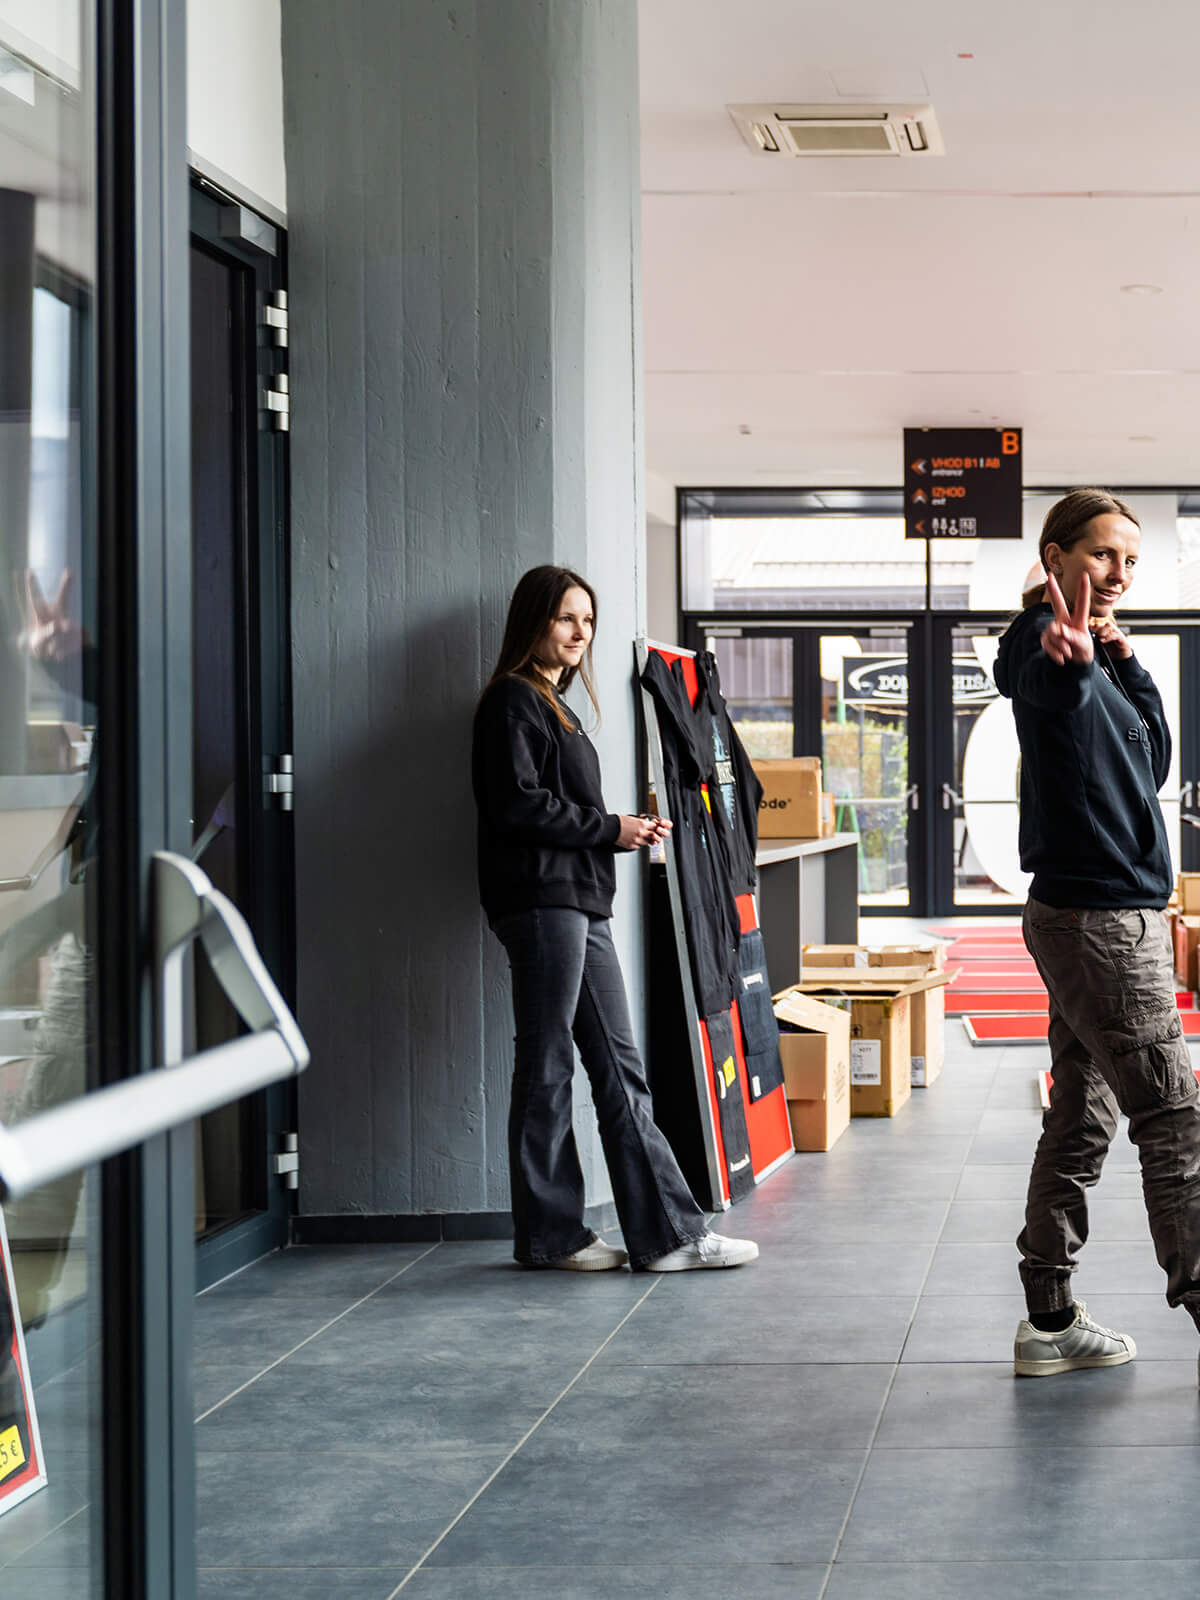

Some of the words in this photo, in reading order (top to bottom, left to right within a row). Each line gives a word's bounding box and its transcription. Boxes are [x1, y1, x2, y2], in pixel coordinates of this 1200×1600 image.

[1002, 432, 1019, 454] B
[931, 457, 962, 469] VHOD
[931, 486, 966, 498] IZHOD
[0, 1440, 18, 1468] 5€
